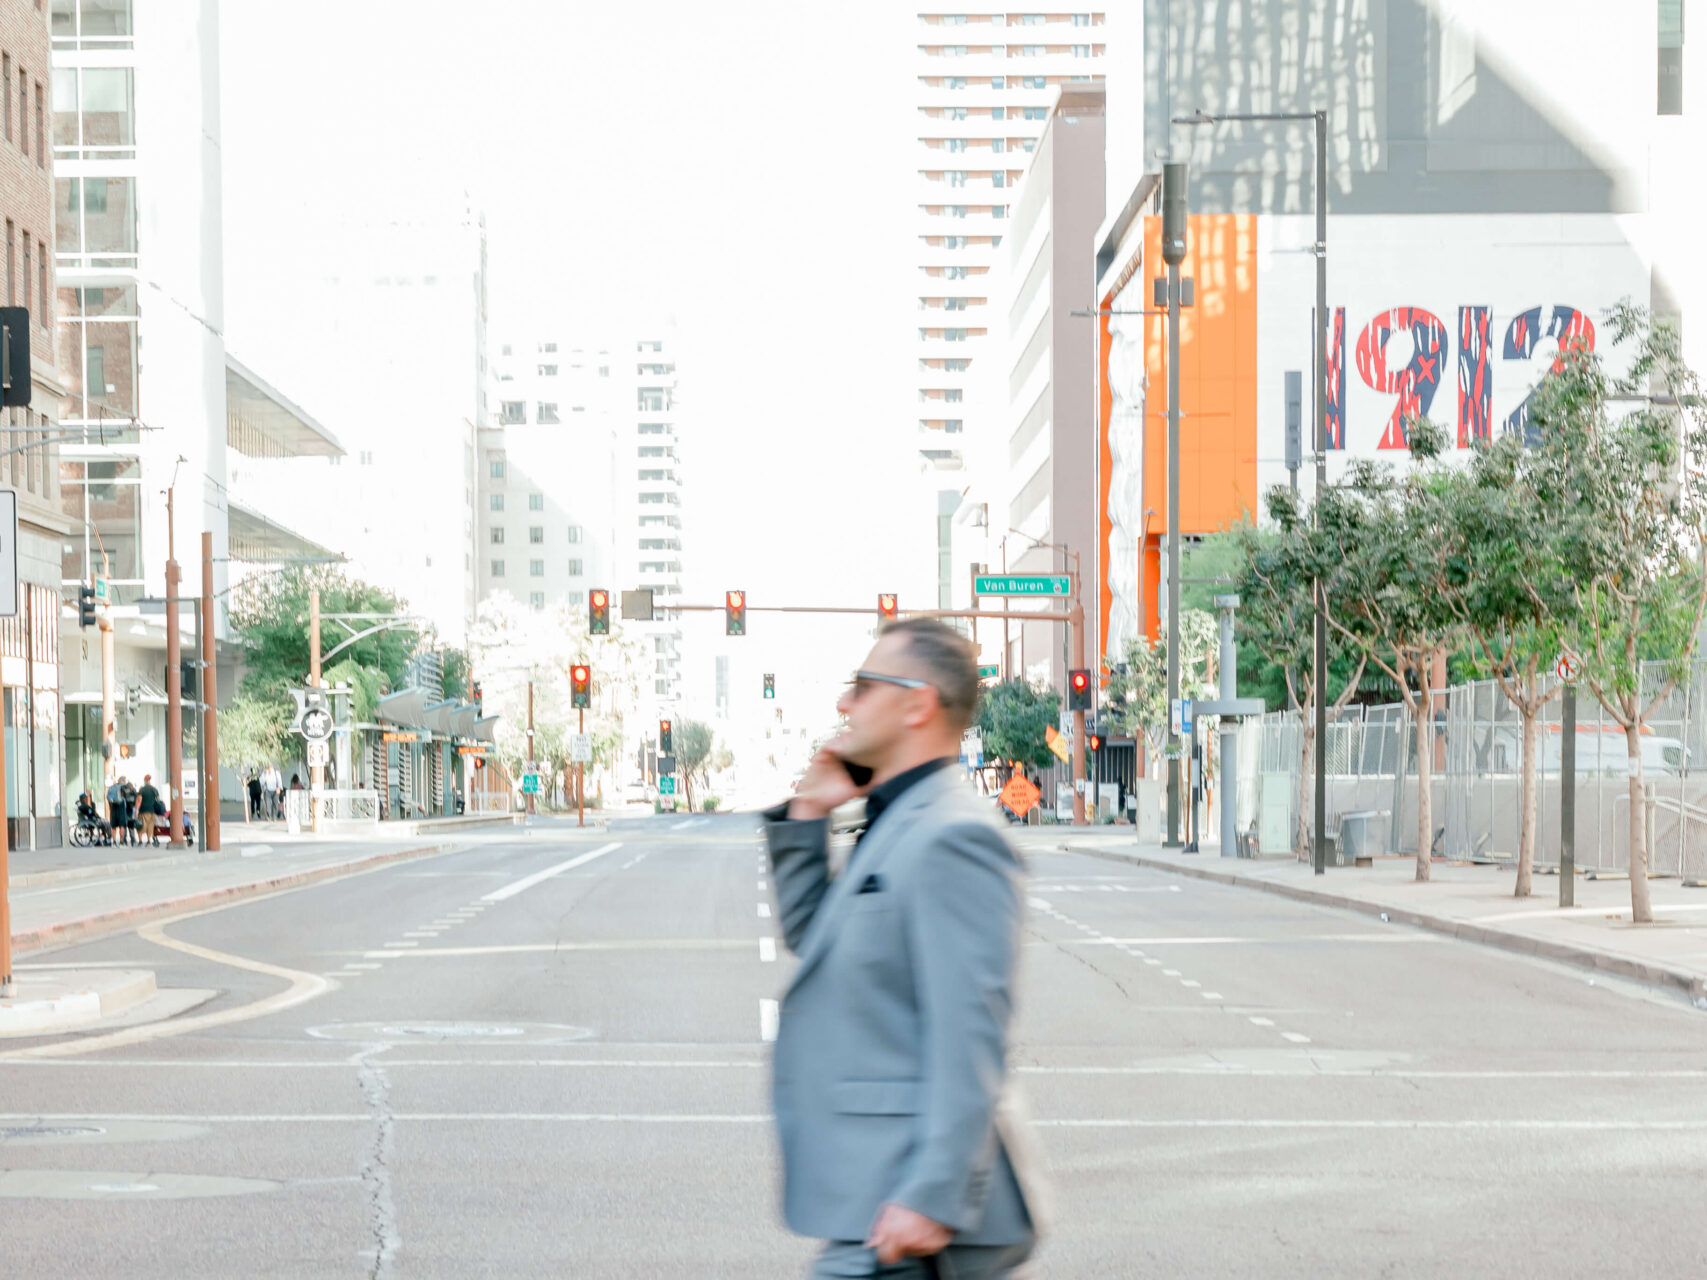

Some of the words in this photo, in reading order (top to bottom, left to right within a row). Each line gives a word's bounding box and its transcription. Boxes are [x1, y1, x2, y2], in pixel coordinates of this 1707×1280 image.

[1312, 304, 1595, 450] 1912
[984, 580, 1005, 591] Van
[1009, 580, 1044, 591] Buren
